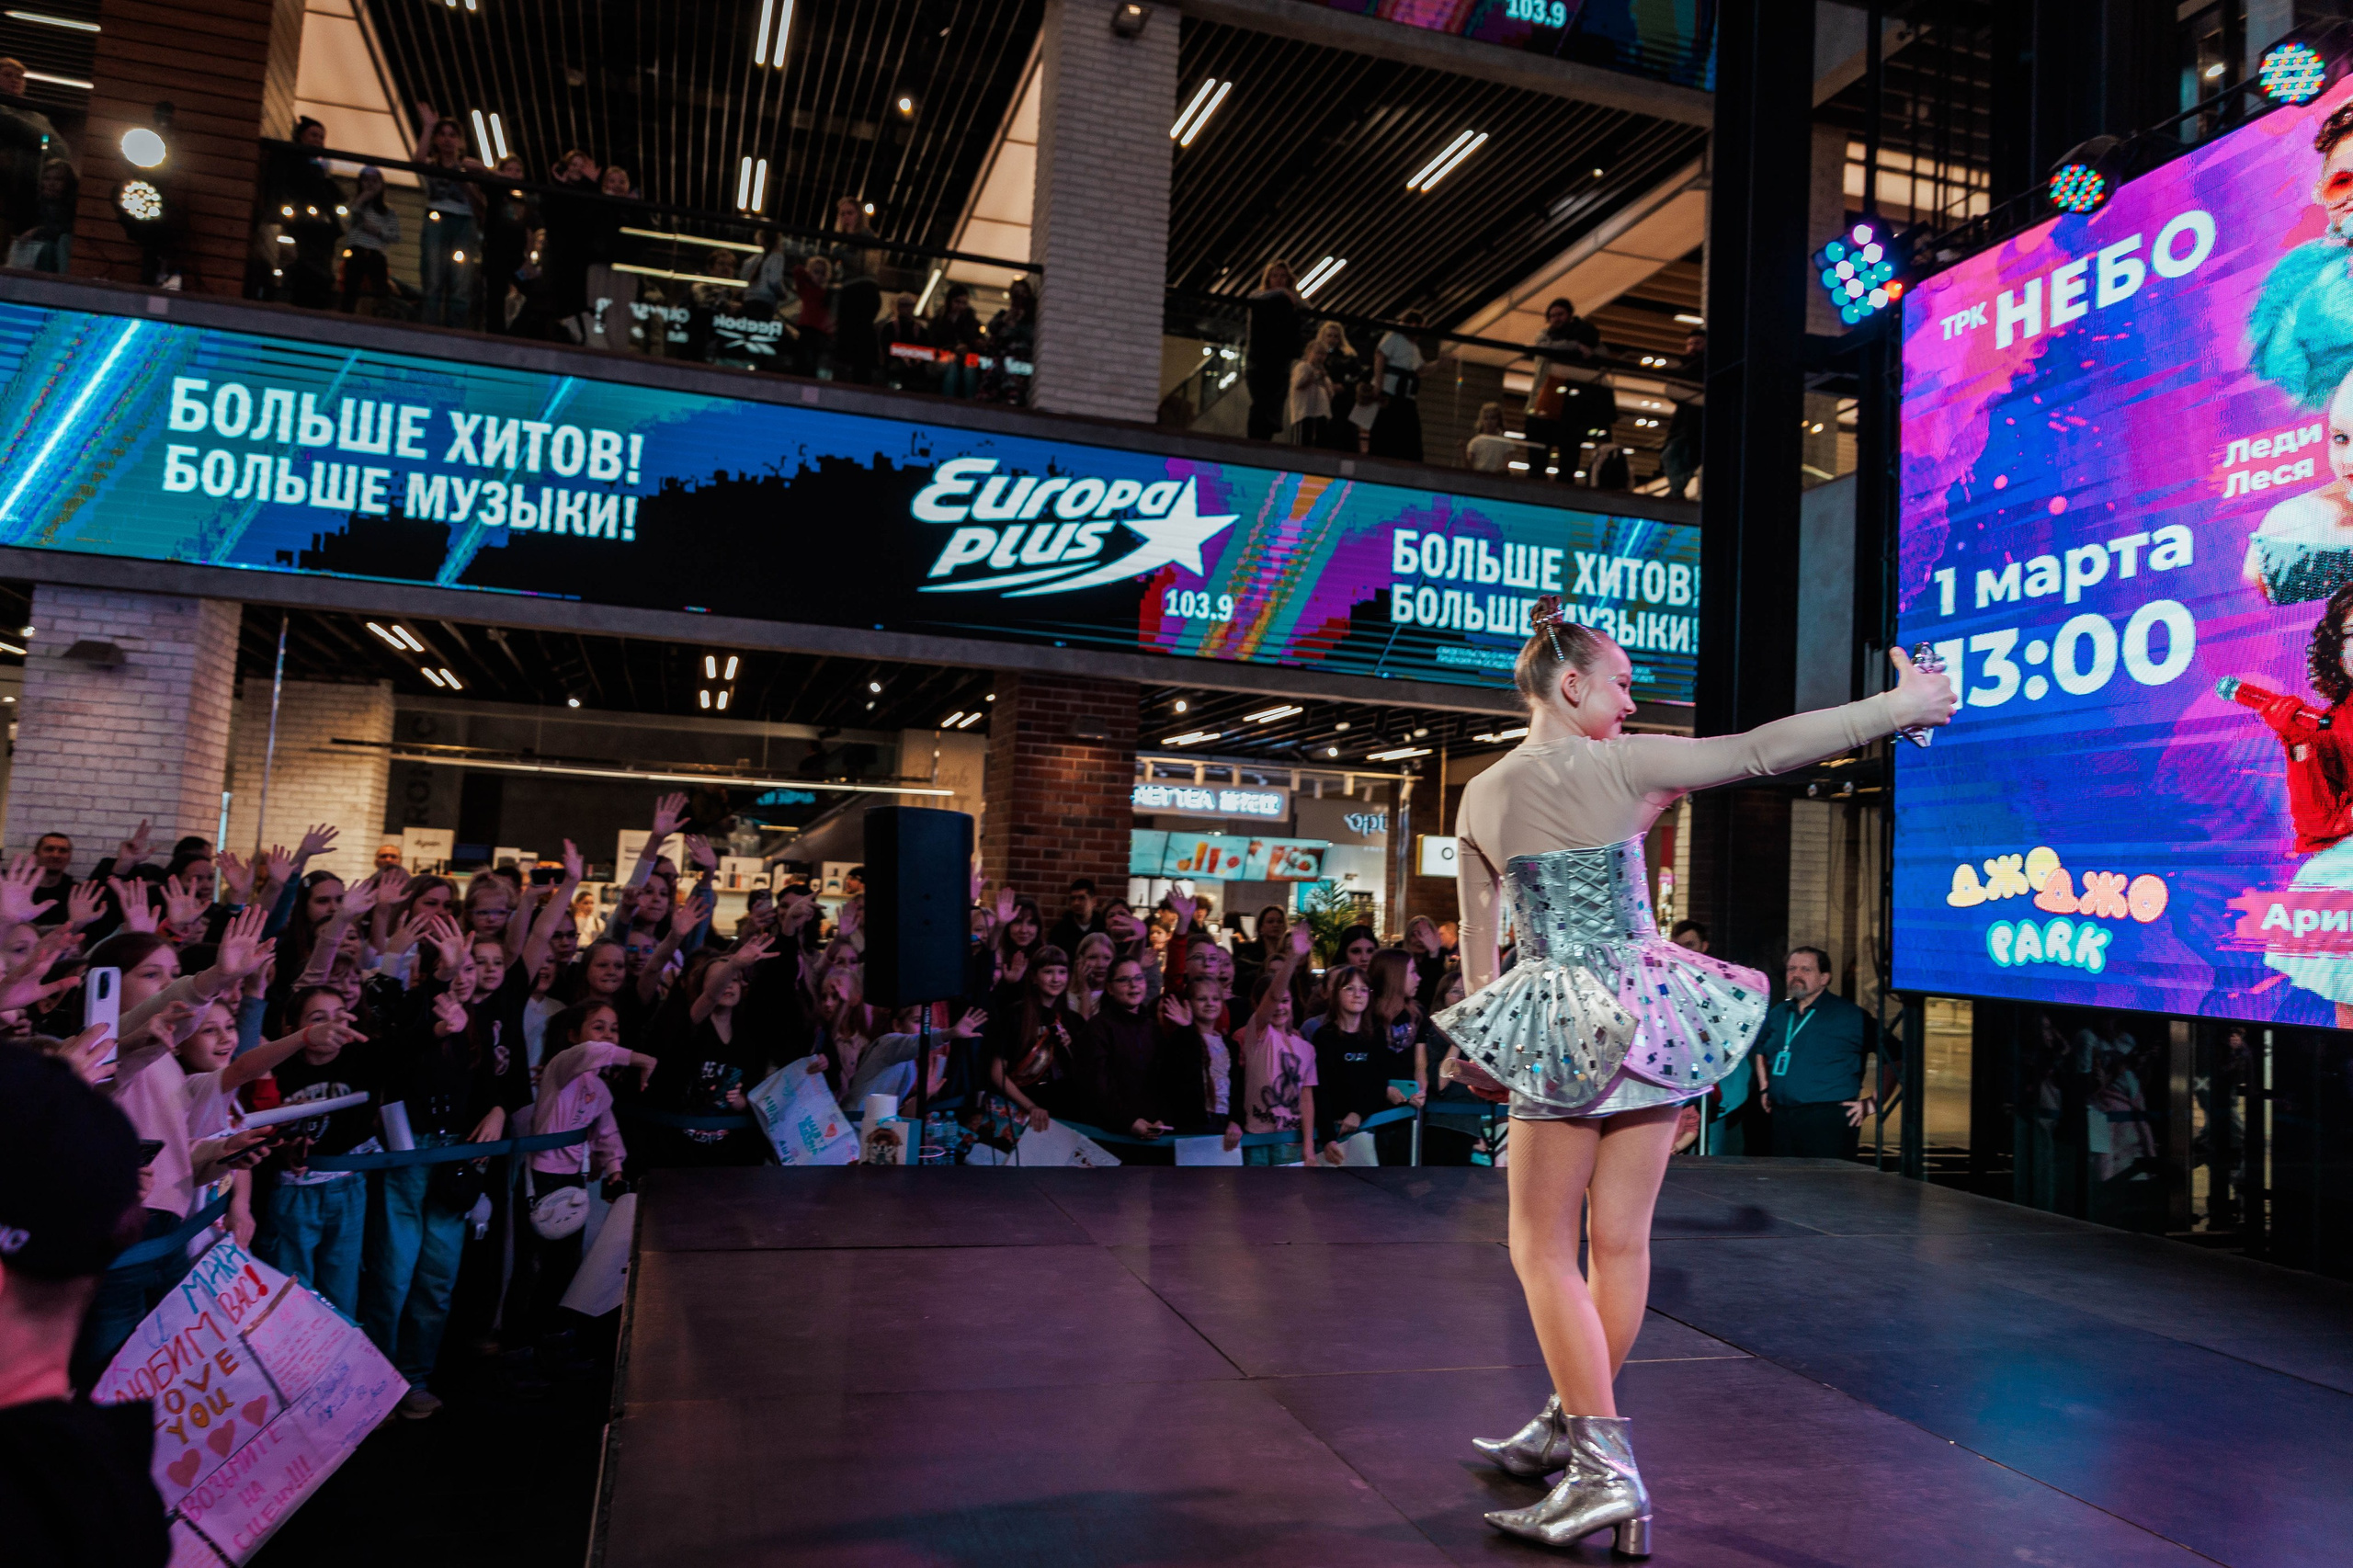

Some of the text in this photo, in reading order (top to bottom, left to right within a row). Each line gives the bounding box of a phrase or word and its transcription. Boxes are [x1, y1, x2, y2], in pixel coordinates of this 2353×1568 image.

[1506, 0, 1567, 28] 103.9
[1939, 210, 2217, 350] ТРК НЕБО
[167, 377, 645, 485] БОЛЬШЕ ХИТОВ!
[2222, 423, 2323, 468] Леди
[163, 445, 639, 542] БОЛЬШЕ МУЗЫКИ!
[2222, 458, 2314, 499] Леся
[1391, 528, 1700, 608] БОЛЬШЕ ХИТОВ!
[1934, 524, 2194, 617] 1 марта
[1165, 588, 1234, 622] 103.9
[1390, 583, 1538, 638] БОЛЬШЕ
[1931, 598, 2198, 710] 13:00
[1946, 846, 2169, 924] ДЖО ДЖО
[1986, 917, 2113, 974] PARK
[218, 1265, 269, 1324] ВАС!
[153, 1346, 239, 1430] OVE
[167, 1388, 234, 1445] YOU
